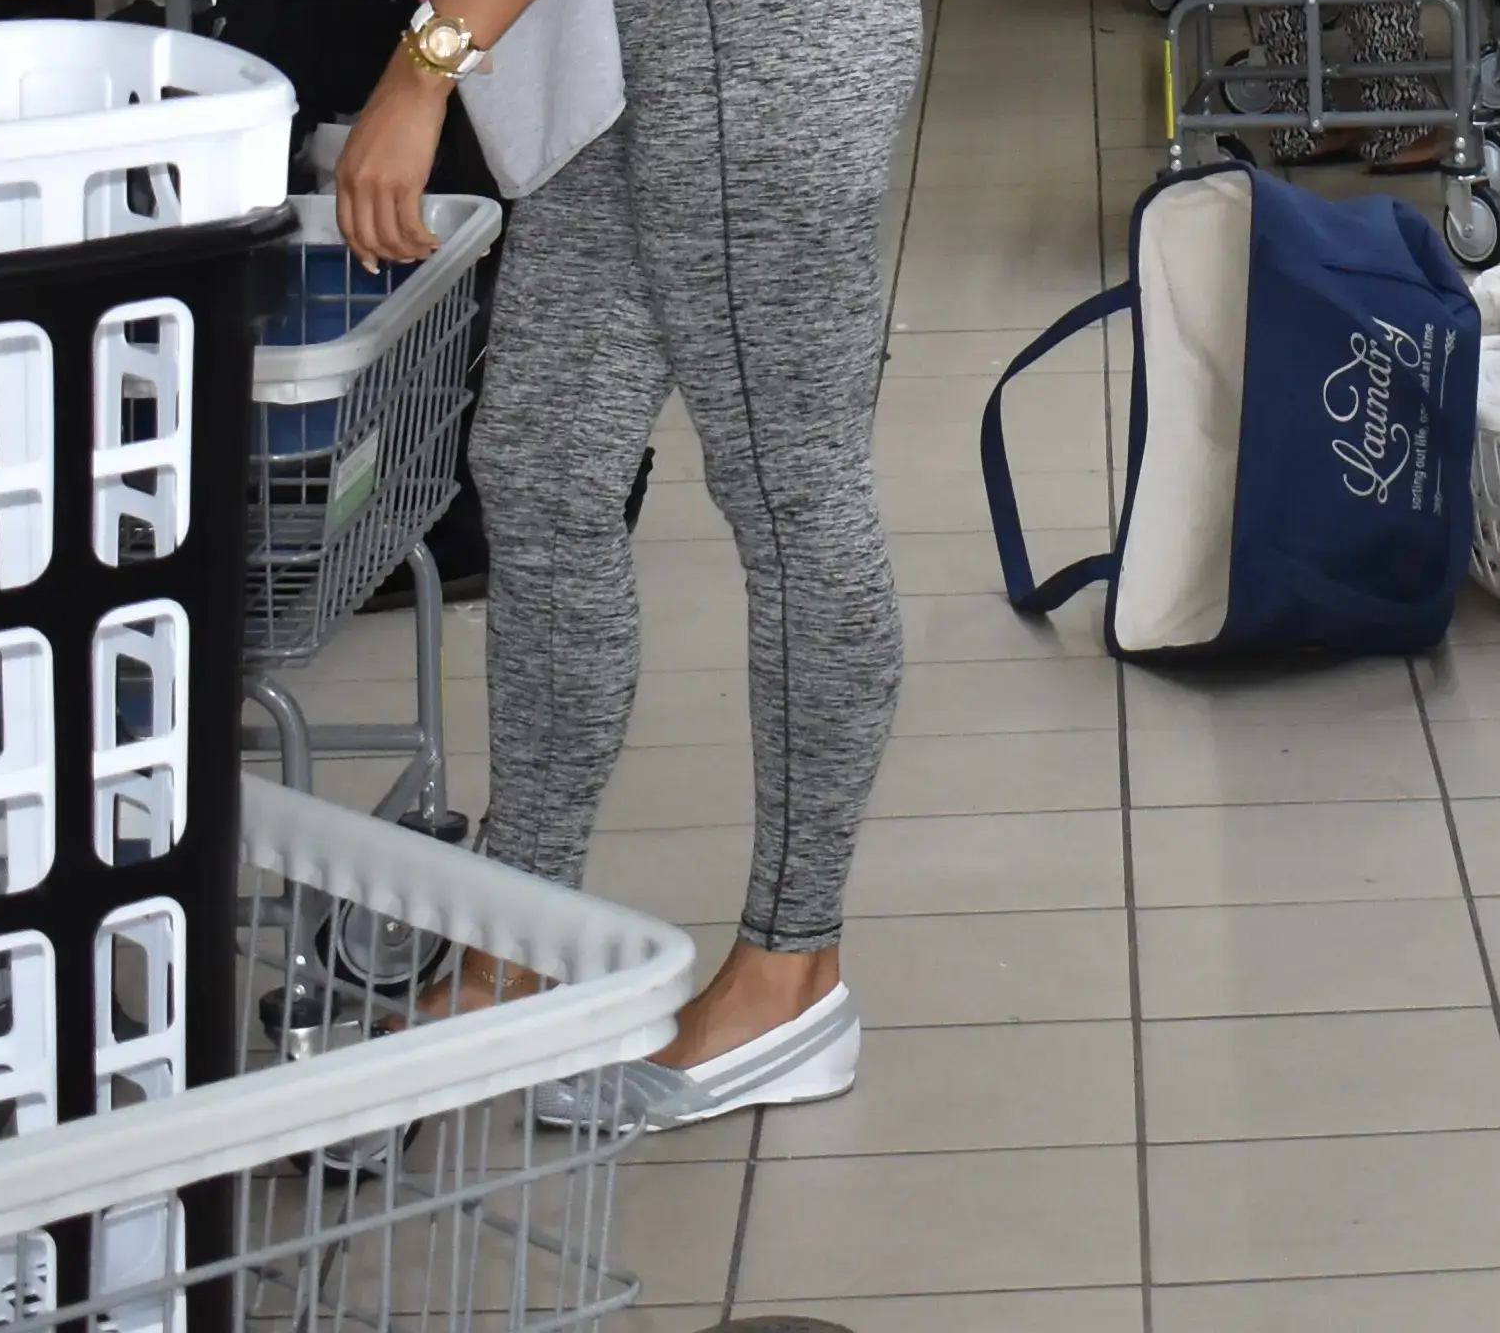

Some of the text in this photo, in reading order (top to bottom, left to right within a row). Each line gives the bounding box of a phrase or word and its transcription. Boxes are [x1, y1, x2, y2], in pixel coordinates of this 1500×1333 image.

[1421, 322, 1435, 351] time
[1323, 316, 1421, 504] Laundry
[1413, 448, 1428, 469] out
[1410, 470, 1428, 511] sorting
